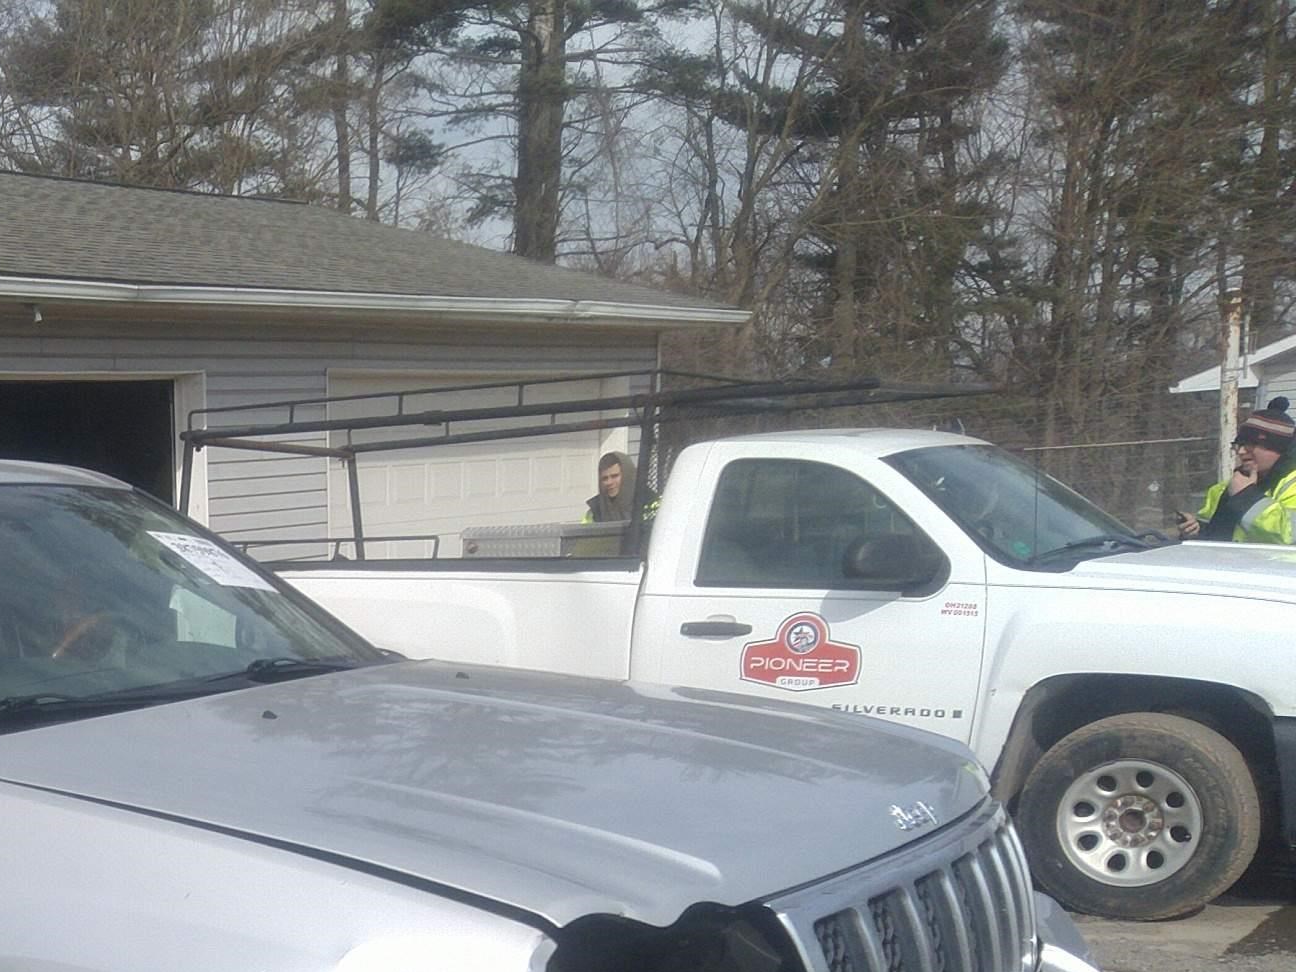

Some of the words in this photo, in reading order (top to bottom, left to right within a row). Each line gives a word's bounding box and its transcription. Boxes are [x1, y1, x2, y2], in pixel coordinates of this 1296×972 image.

[750, 657, 850, 673] PIONEER
[780, 678, 816, 687] GROUP
[831, 703, 946, 718] SILVERADO
